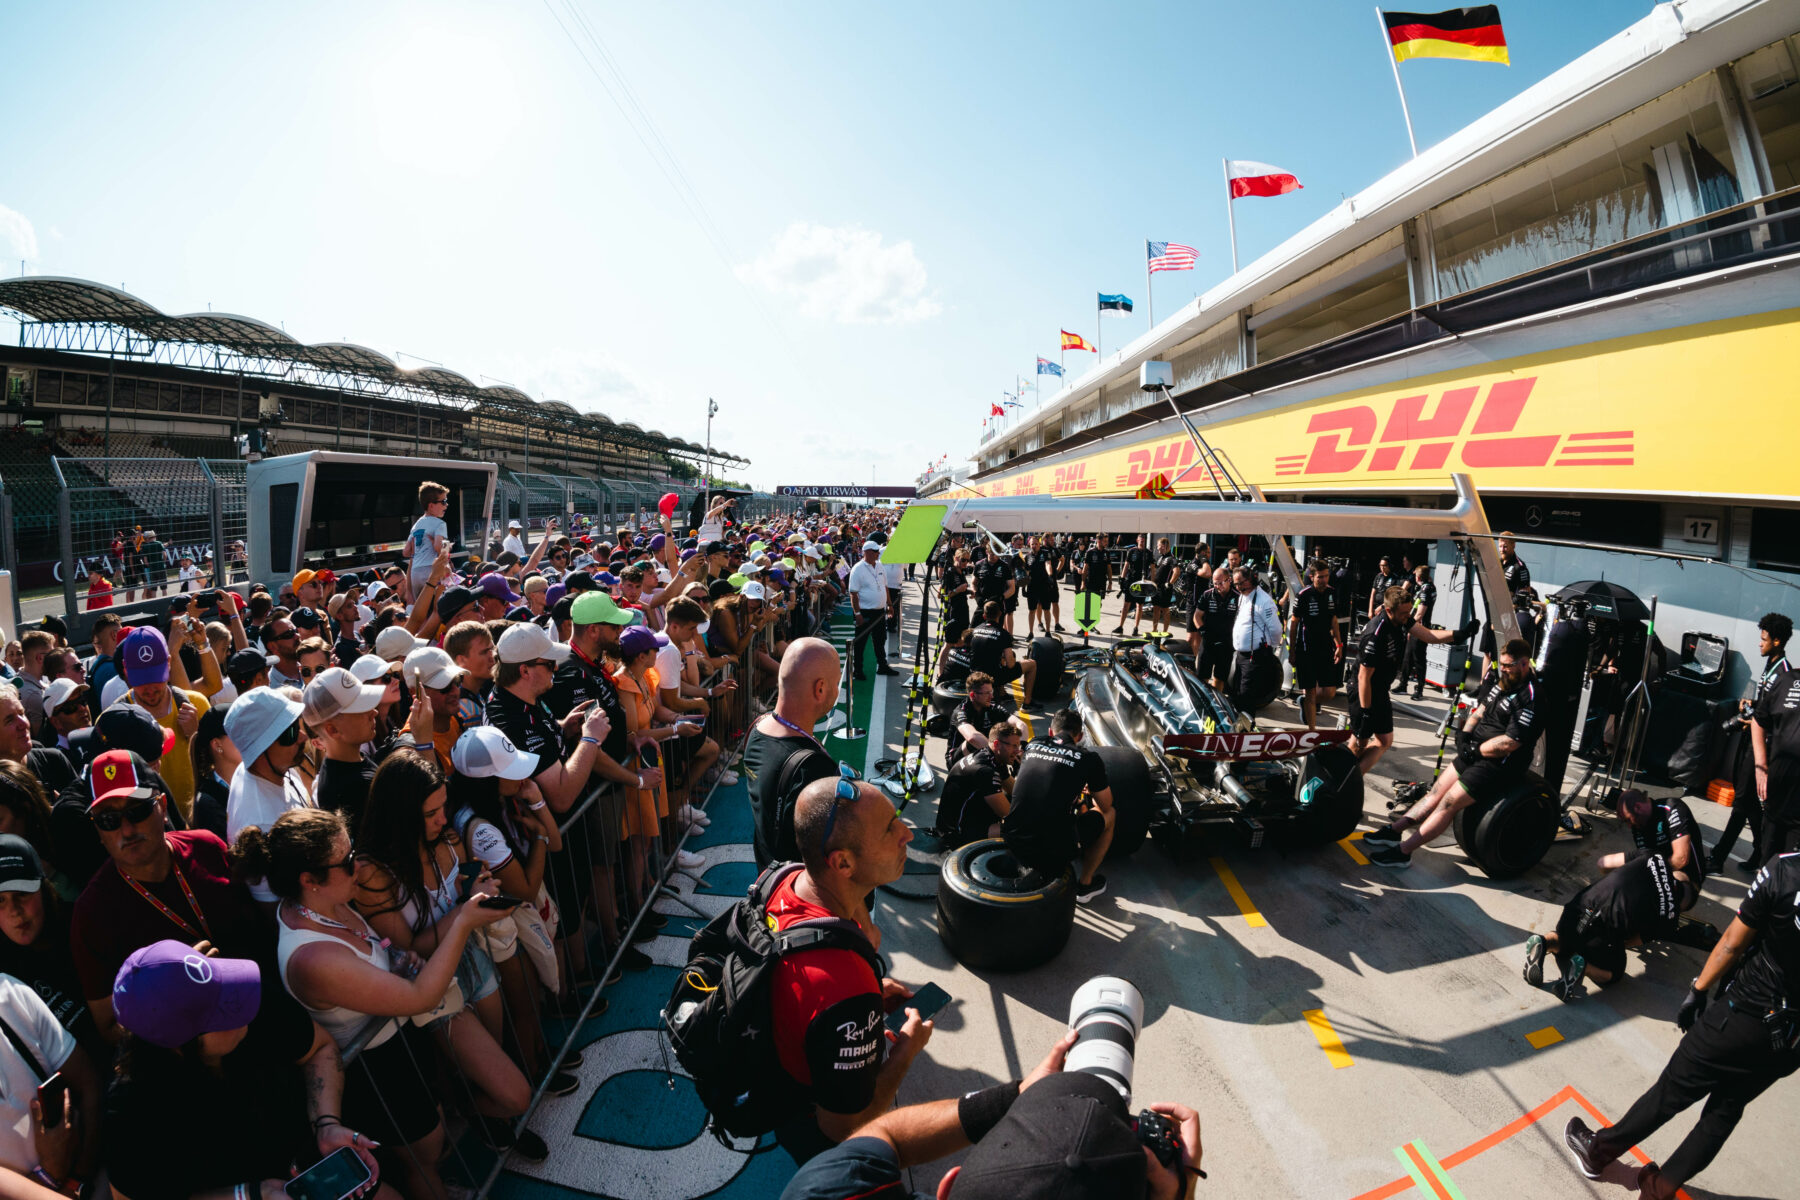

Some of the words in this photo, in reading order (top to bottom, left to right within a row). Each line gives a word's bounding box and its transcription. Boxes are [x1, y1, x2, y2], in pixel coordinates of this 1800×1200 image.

[1304, 376, 1562, 475] DHL
[1054, 462, 1089, 492] DHL
[1126, 439, 1204, 487] DHL
[783, 486, 819, 497] QATAR
[822, 486, 868, 496] AIRWAYS
[1690, 521, 1712, 539] 17
[1026, 743, 1082, 761] PETRONAS
[1200, 731, 1321, 758] INEOS
[1649, 857, 1666, 915] CROWDSTRIKE
[1654, 853, 1675, 919] PETRONAS
